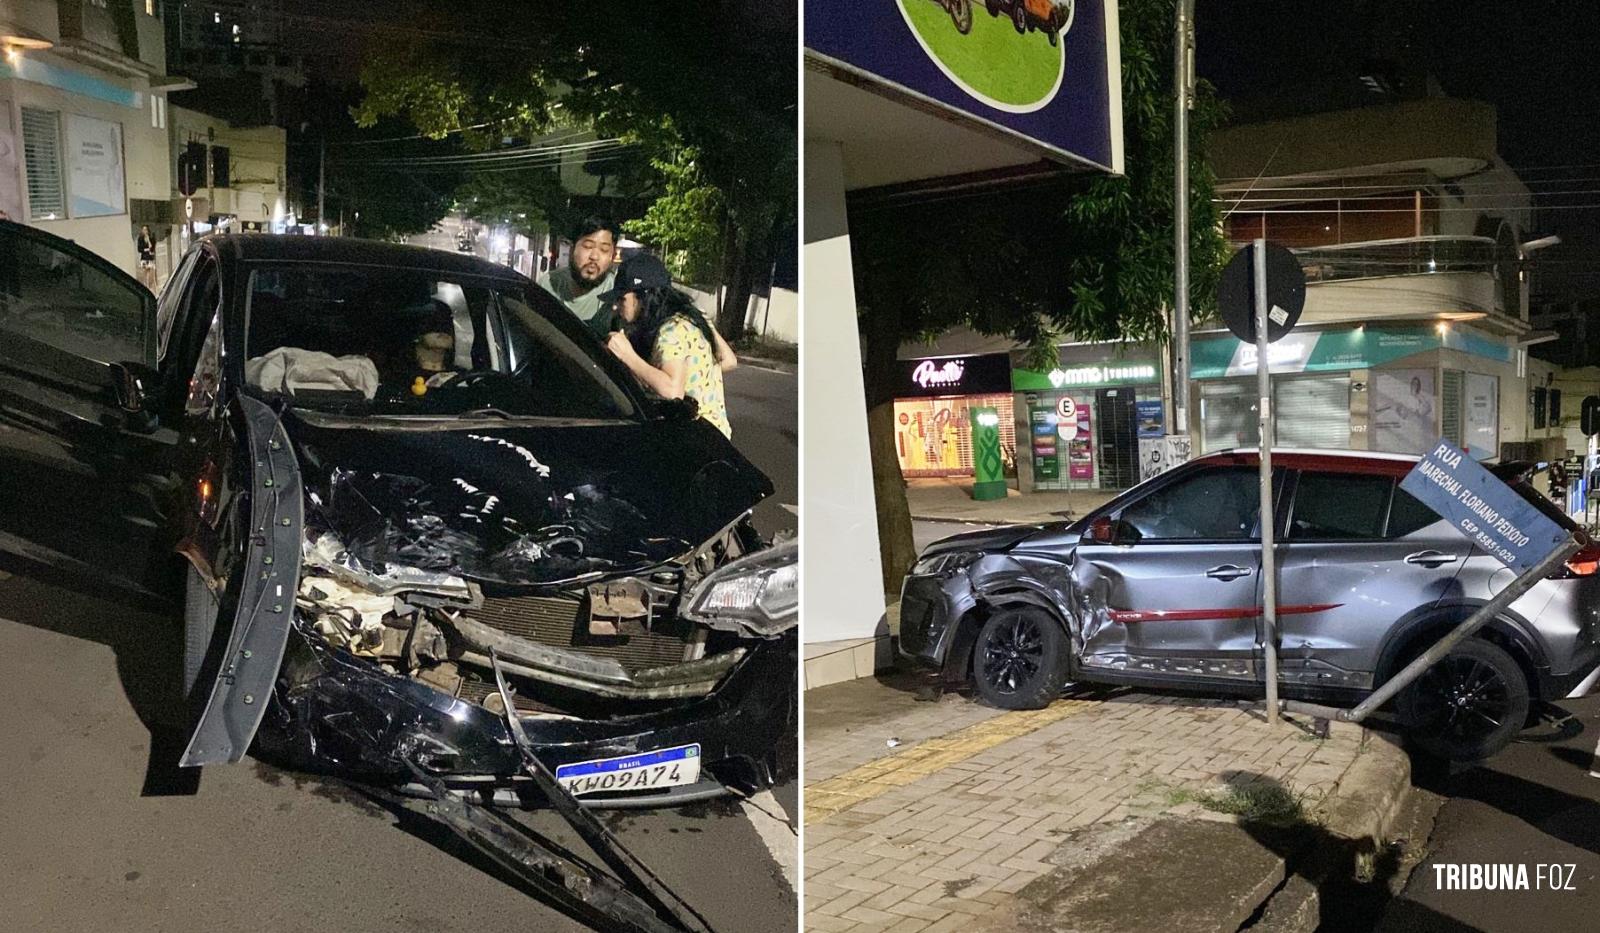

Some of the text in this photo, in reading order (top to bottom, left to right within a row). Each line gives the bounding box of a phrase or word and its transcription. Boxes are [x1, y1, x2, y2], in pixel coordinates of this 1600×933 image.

[1063, 400, 1070, 413] E
[1434, 444, 1462, 469] RUA
[1418, 461, 1530, 548] MARECHAL FLORIANO PEIXOTO
[1460, 518, 1516, 563] CEP 85851-020
[618, 761, 641, 770] BRASIL
